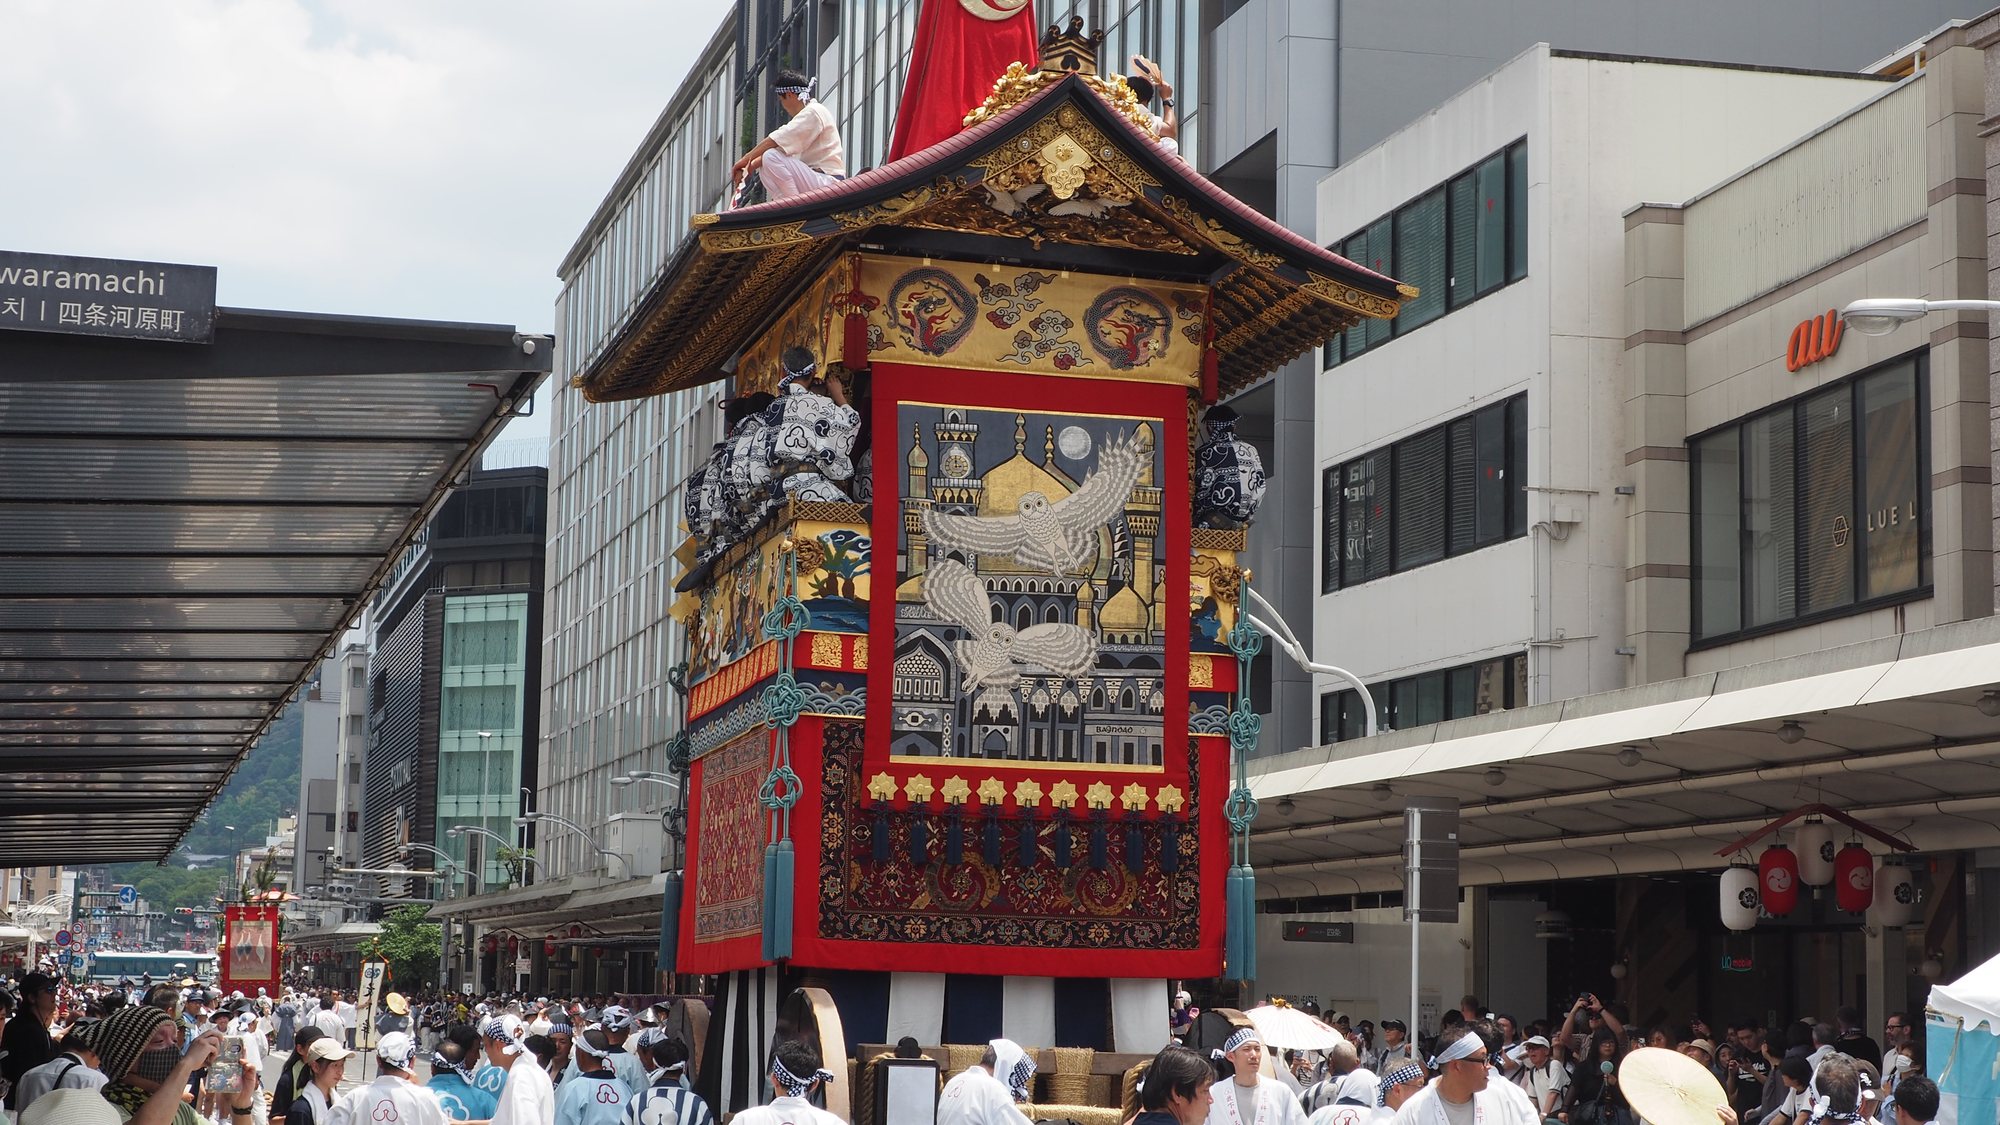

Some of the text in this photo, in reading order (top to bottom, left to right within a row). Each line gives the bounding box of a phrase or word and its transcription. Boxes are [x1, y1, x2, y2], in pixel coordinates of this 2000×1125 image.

[58, 302, 185, 333] 四条河原町
[1786, 308, 1844, 373] au
[1867, 506, 1898, 532] LUE
